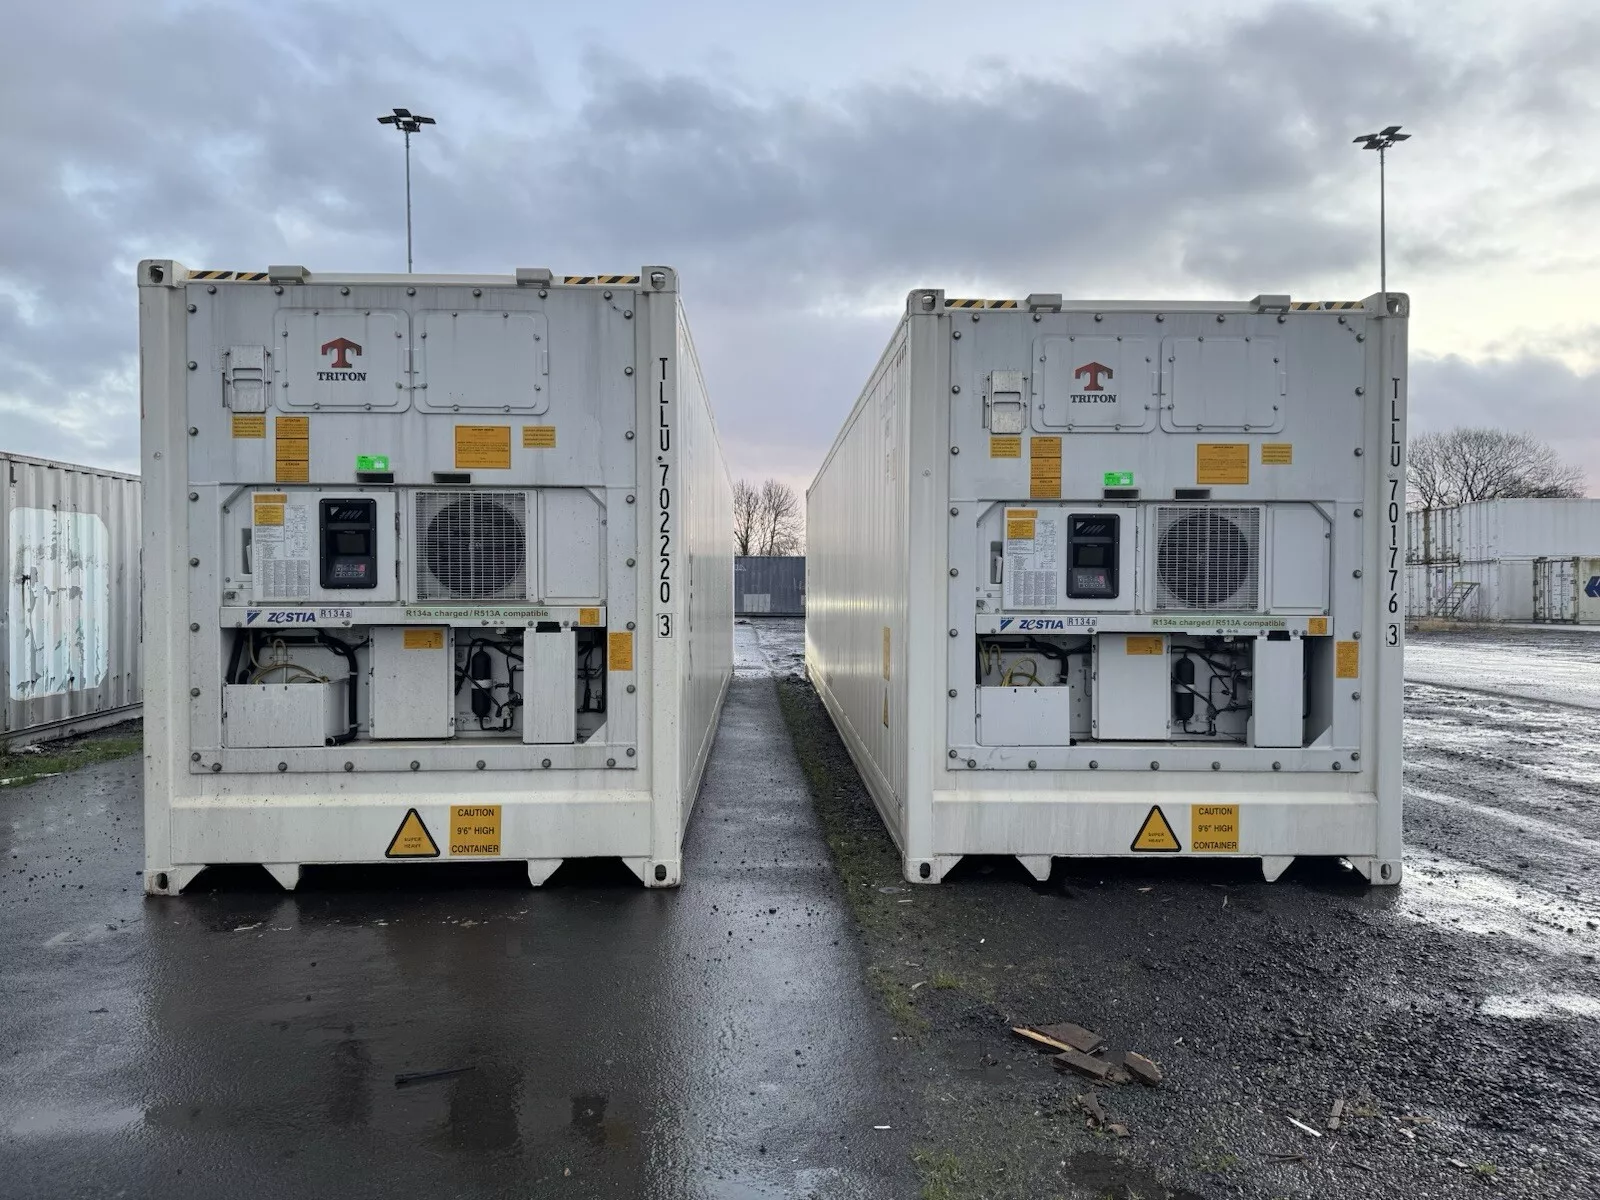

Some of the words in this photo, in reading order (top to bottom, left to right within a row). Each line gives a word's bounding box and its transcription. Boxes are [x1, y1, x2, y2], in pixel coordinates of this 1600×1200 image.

[316, 371, 367, 381] TRITON
[1070, 394, 1117, 403] TRITON
[659, 358, 670, 452] TLLU
[1391, 378, 1400, 467] TLLU
[659, 464, 670, 603] 702220
[1388, 479, 1398, 613] 701776
[321, 609, 352, 618] R134a
[435, 609, 468, 619] charged
[503, 609, 549, 619] compatible
[660, 615, 670, 637] 3
[1068, 617, 1096, 626] R134a
[1179, 619, 1211, 628] charged
[1243, 619, 1286, 628] compatible
[1388, 624, 1398, 646] 3
[457, 808, 495, 817] CAUTION
[1198, 807, 1233, 815] CAUTION
[474, 826, 495, 835] HIGH
[1214, 824, 1233, 832] HIGH
[451, 844, 499, 853] CONTAINER
[1193, 841, 1237, 850] CONTAINER
